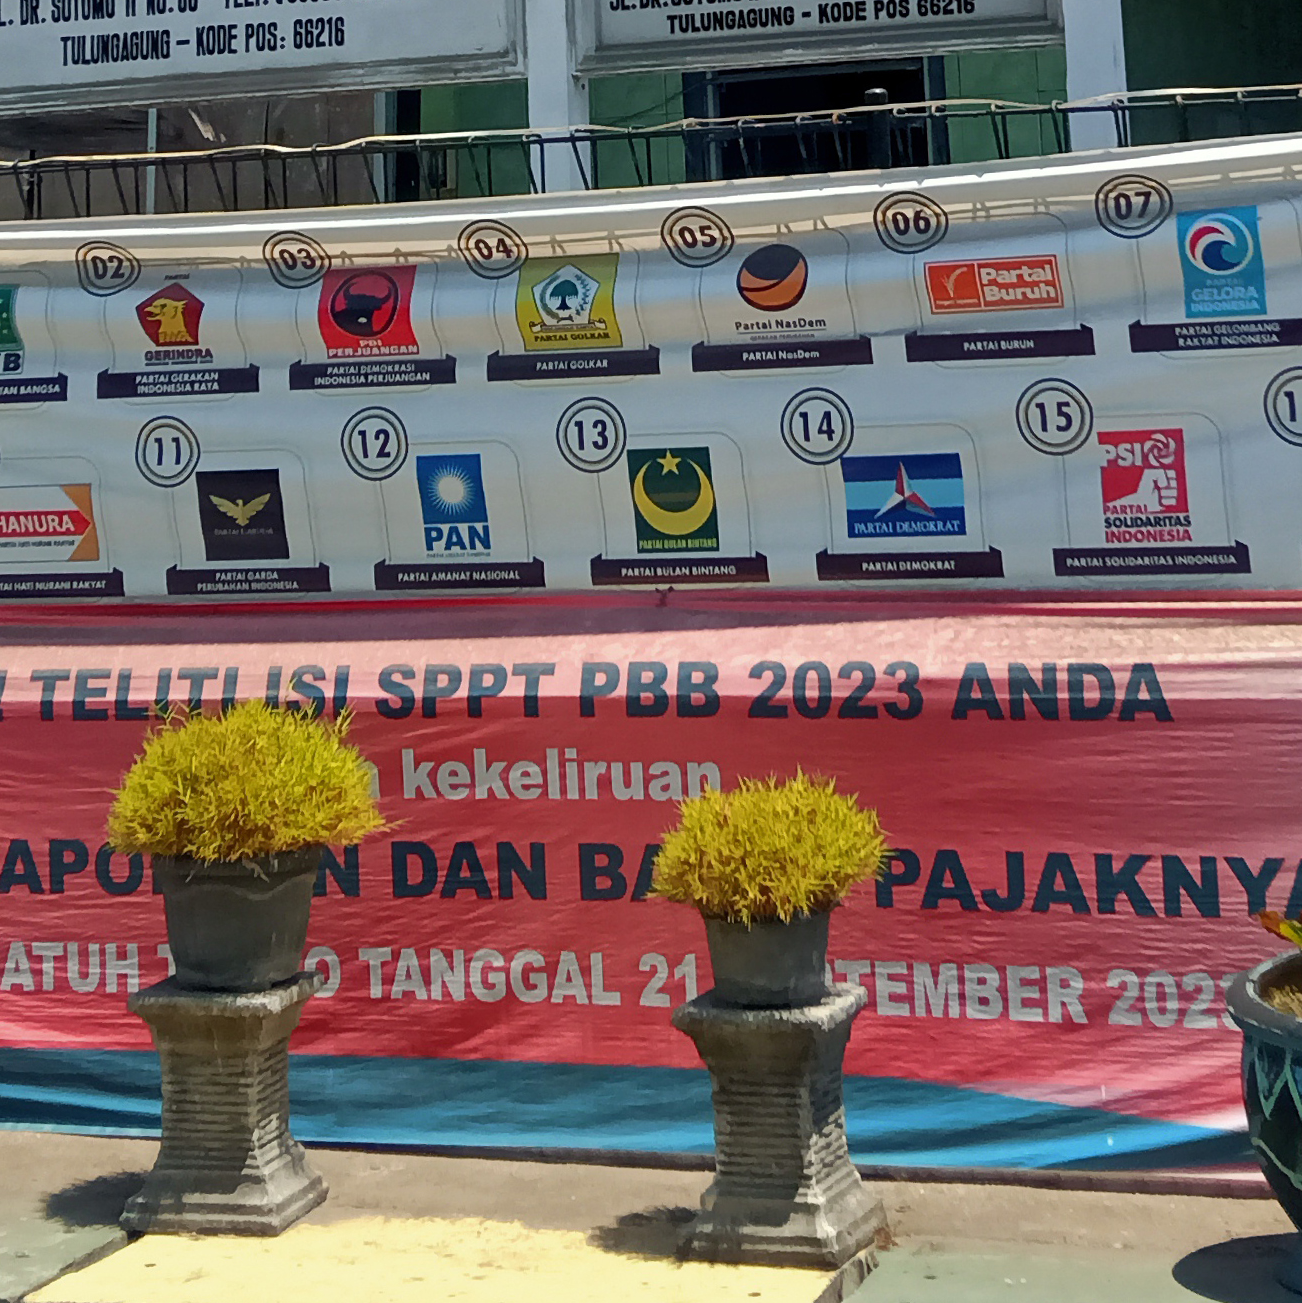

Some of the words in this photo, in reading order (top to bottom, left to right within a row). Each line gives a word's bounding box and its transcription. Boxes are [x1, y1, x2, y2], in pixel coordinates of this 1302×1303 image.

[667, 7, 794, 34] TULUNGAGUNG
[818, 0, 867, 24] KODE
[874, 0, 910, 20] POS
[60, 32, 170, 66] TULUNGAGUNG
[196, 26, 237, 56] KODE
[243, 22, 286, 52] POS:
[293, 17, 345, 49] 66216
[1114, 191, 1152, 221] 07
[892, 210, 931, 235] 06
[474, 238, 512, 260] 04
[678, 225, 717, 249] 05
[278, 248, 315, 270] 03
[980, 265, 1051, 285] Partai
[984, 286, 1055, 301] Buruh
[1191, 286, 1258, 299] GELORA
[735, 319, 772, 331] Partai
[775, 317, 826, 328] NasDem
[145, 348, 213, 361] GERINDRA
[328, 345, 418, 356] PERJUANGAN
[742, 351, 776, 361] PARTAI
[779, 349, 819, 359] NasDem
[536, 361, 567, 370] PARTAI
[570, 359, 608, 369] GOLKAR
[799, 409, 835, 443] 14
[1035, 401, 1073, 433] 15
[357, 428, 392, 460] 12
[574, 419, 609, 451] 13
[153, 437, 182, 466] 11
[1100, 443, 1141, 468] PSI
[1103, 504, 1148, 515] PARTAI
[1104, 514, 1191, 529] SOLIDARITAS
[424, 525, 492, 551] PAN
[854, 522, 892, 534] PARTAI
[897, 520, 960, 533] DEMOKRAT
[1105, 528, 1192, 543] INDONESIA
[31, 665, 239, 721] TELITI
[265, 665, 351, 720] ISI
[375, 662, 555, 720] SPPT
[580, 660, 720, 719] PBB
[748, 660, 923, 721] 2023
[951, 662, 1174, 723] ANDA
[392, 842, 552, 900] DAN
[358, 947, 621, 1007] TANGGAL
[639, 952, 698, 1007] 21
